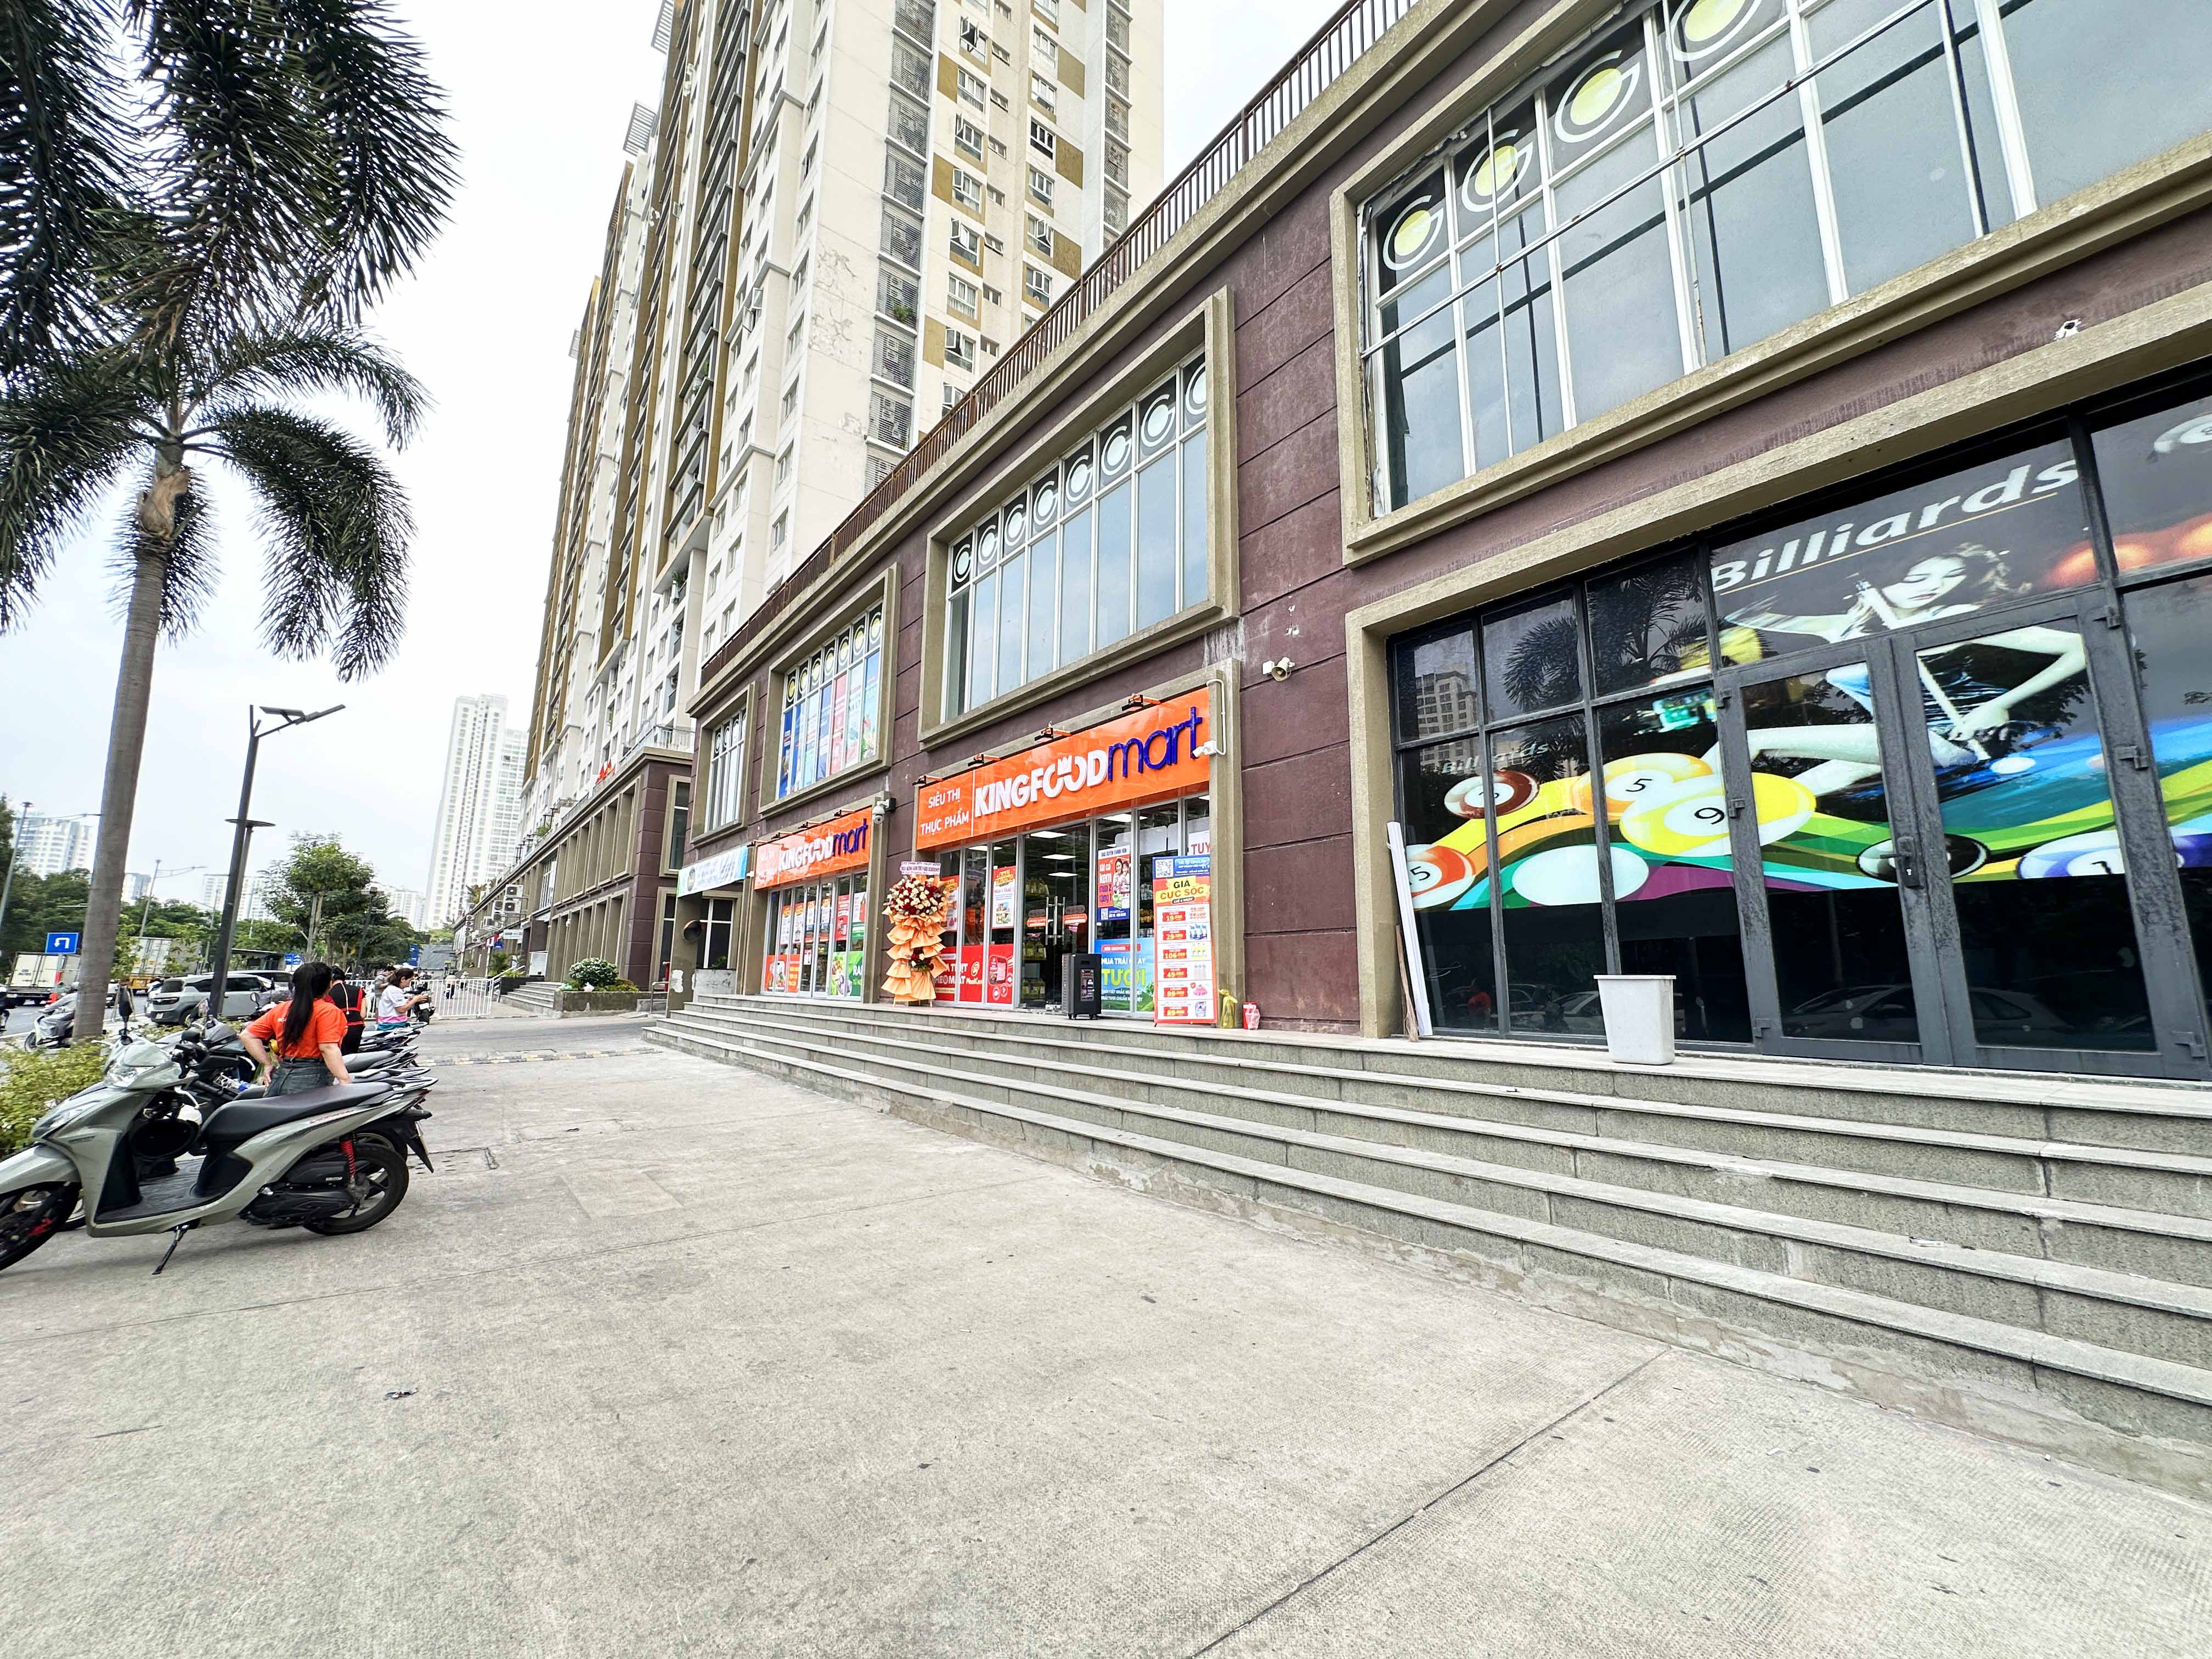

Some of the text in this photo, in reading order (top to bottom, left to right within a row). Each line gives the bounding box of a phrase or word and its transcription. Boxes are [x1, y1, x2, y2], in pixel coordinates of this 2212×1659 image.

[1711, 459, 2078, 592] Billiards
[1626, 778, 1653, 792] 5
[928, 787, 961, 808] SIÊU THỊ
[919, 807, 969, 836] THỰC PHẨM
[1694, 807, 1725, 825] 9
